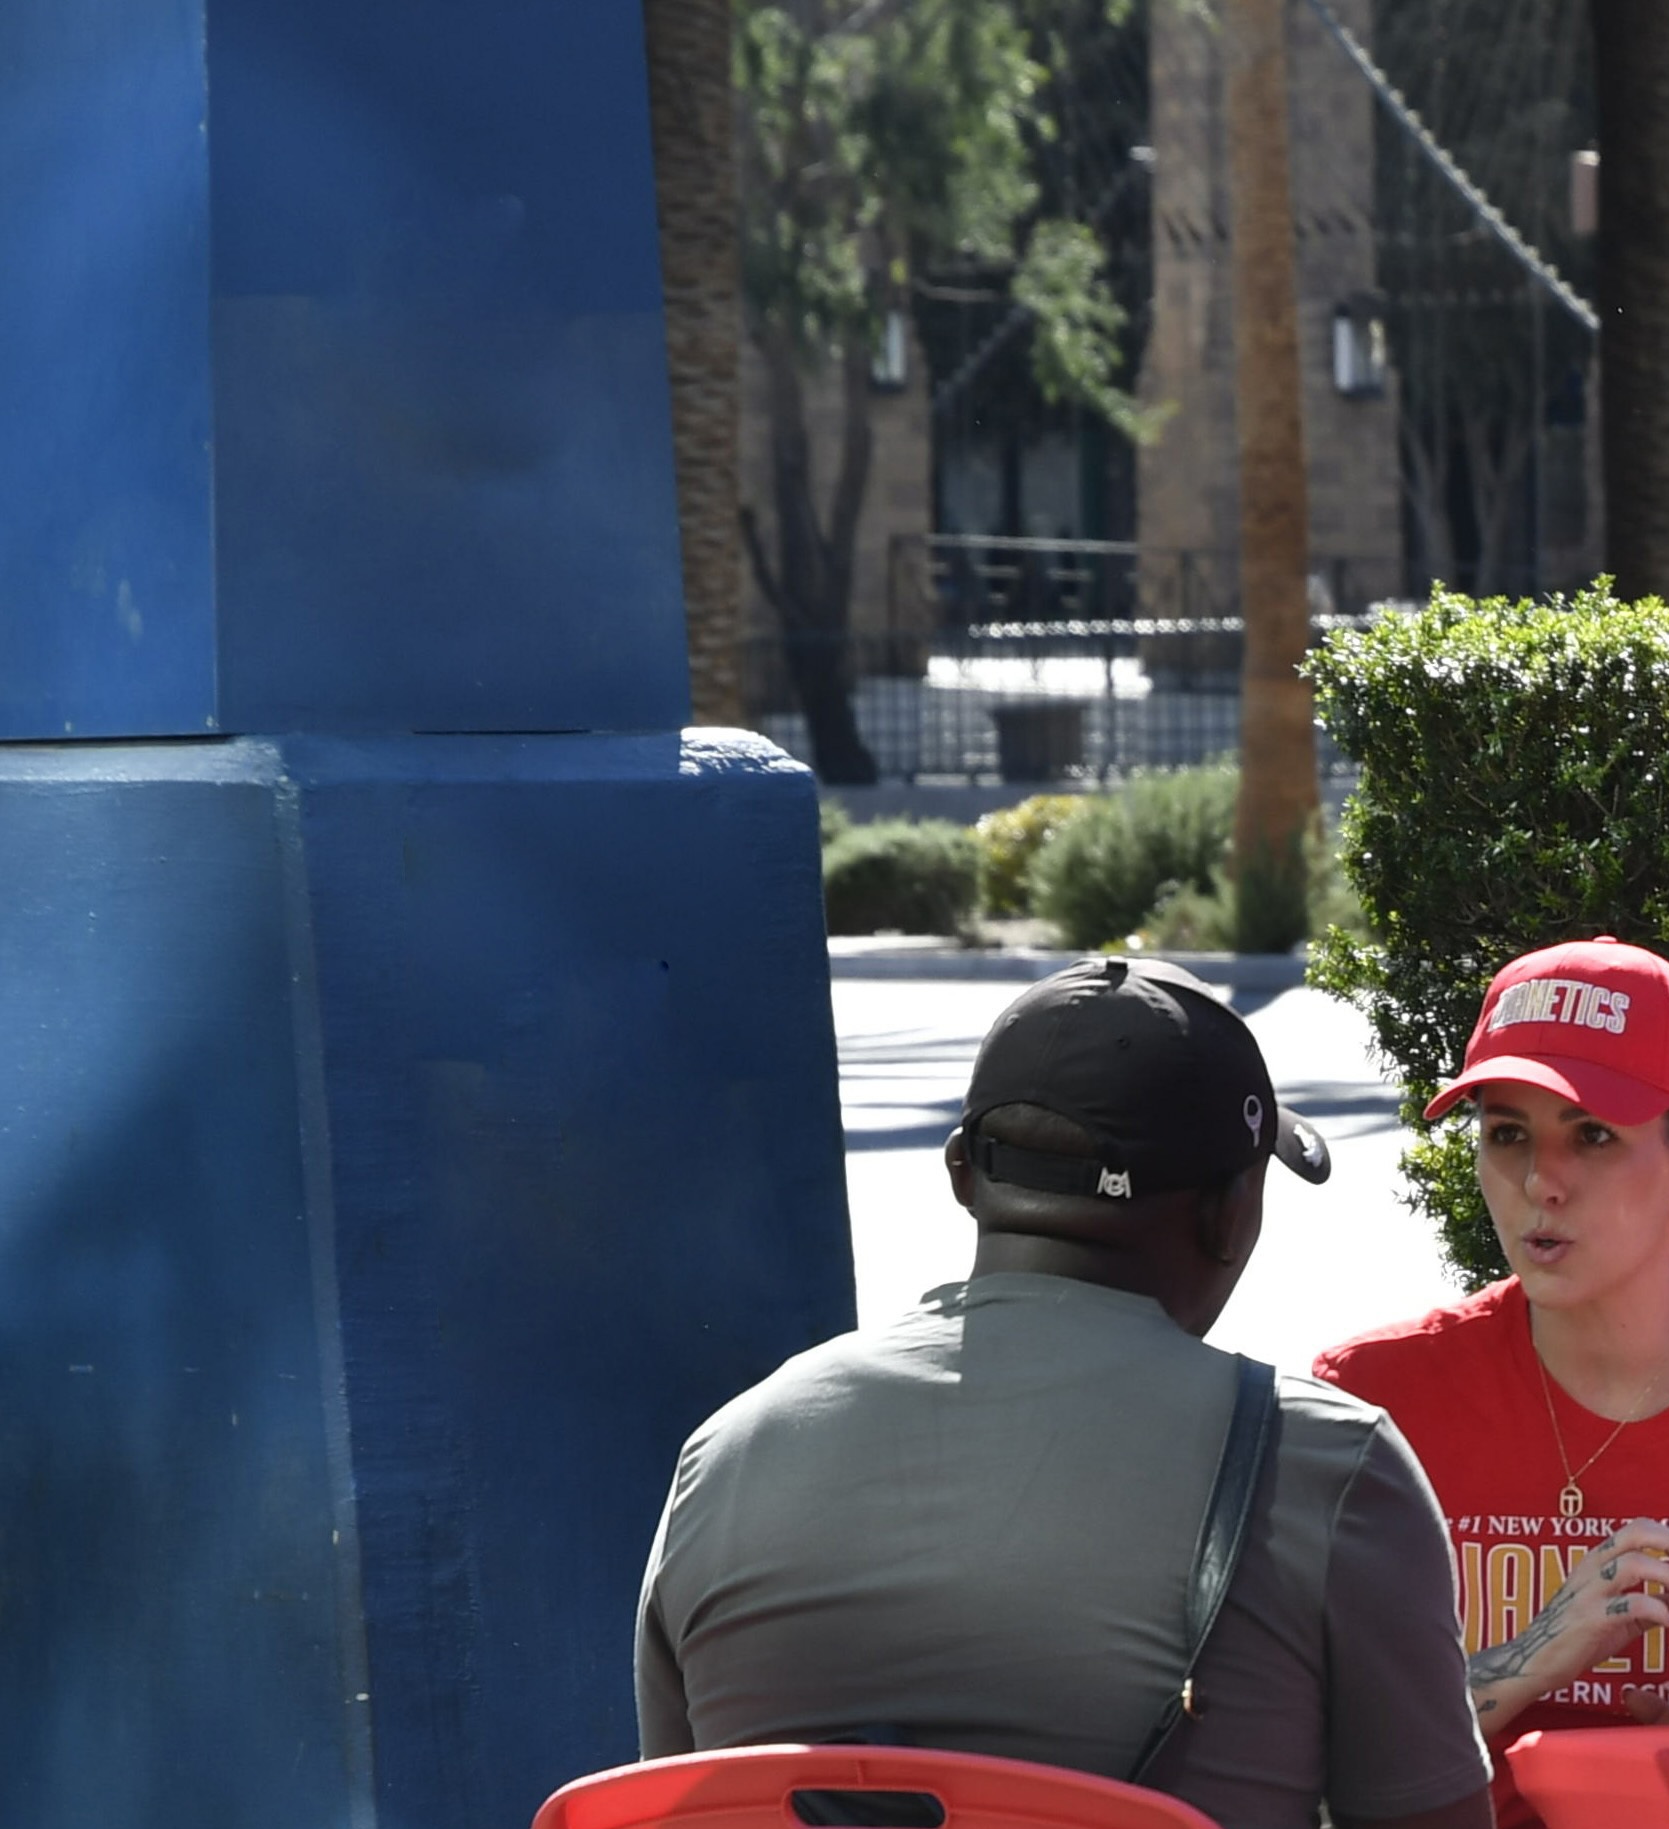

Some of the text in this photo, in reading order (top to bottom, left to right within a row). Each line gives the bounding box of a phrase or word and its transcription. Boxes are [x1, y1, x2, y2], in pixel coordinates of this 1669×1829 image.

[1458, 1516, 1481, 1533] #1
[1487, 1515, 1545, 1535] NEW
[1551, 1516, 1615, 1537] YORK
